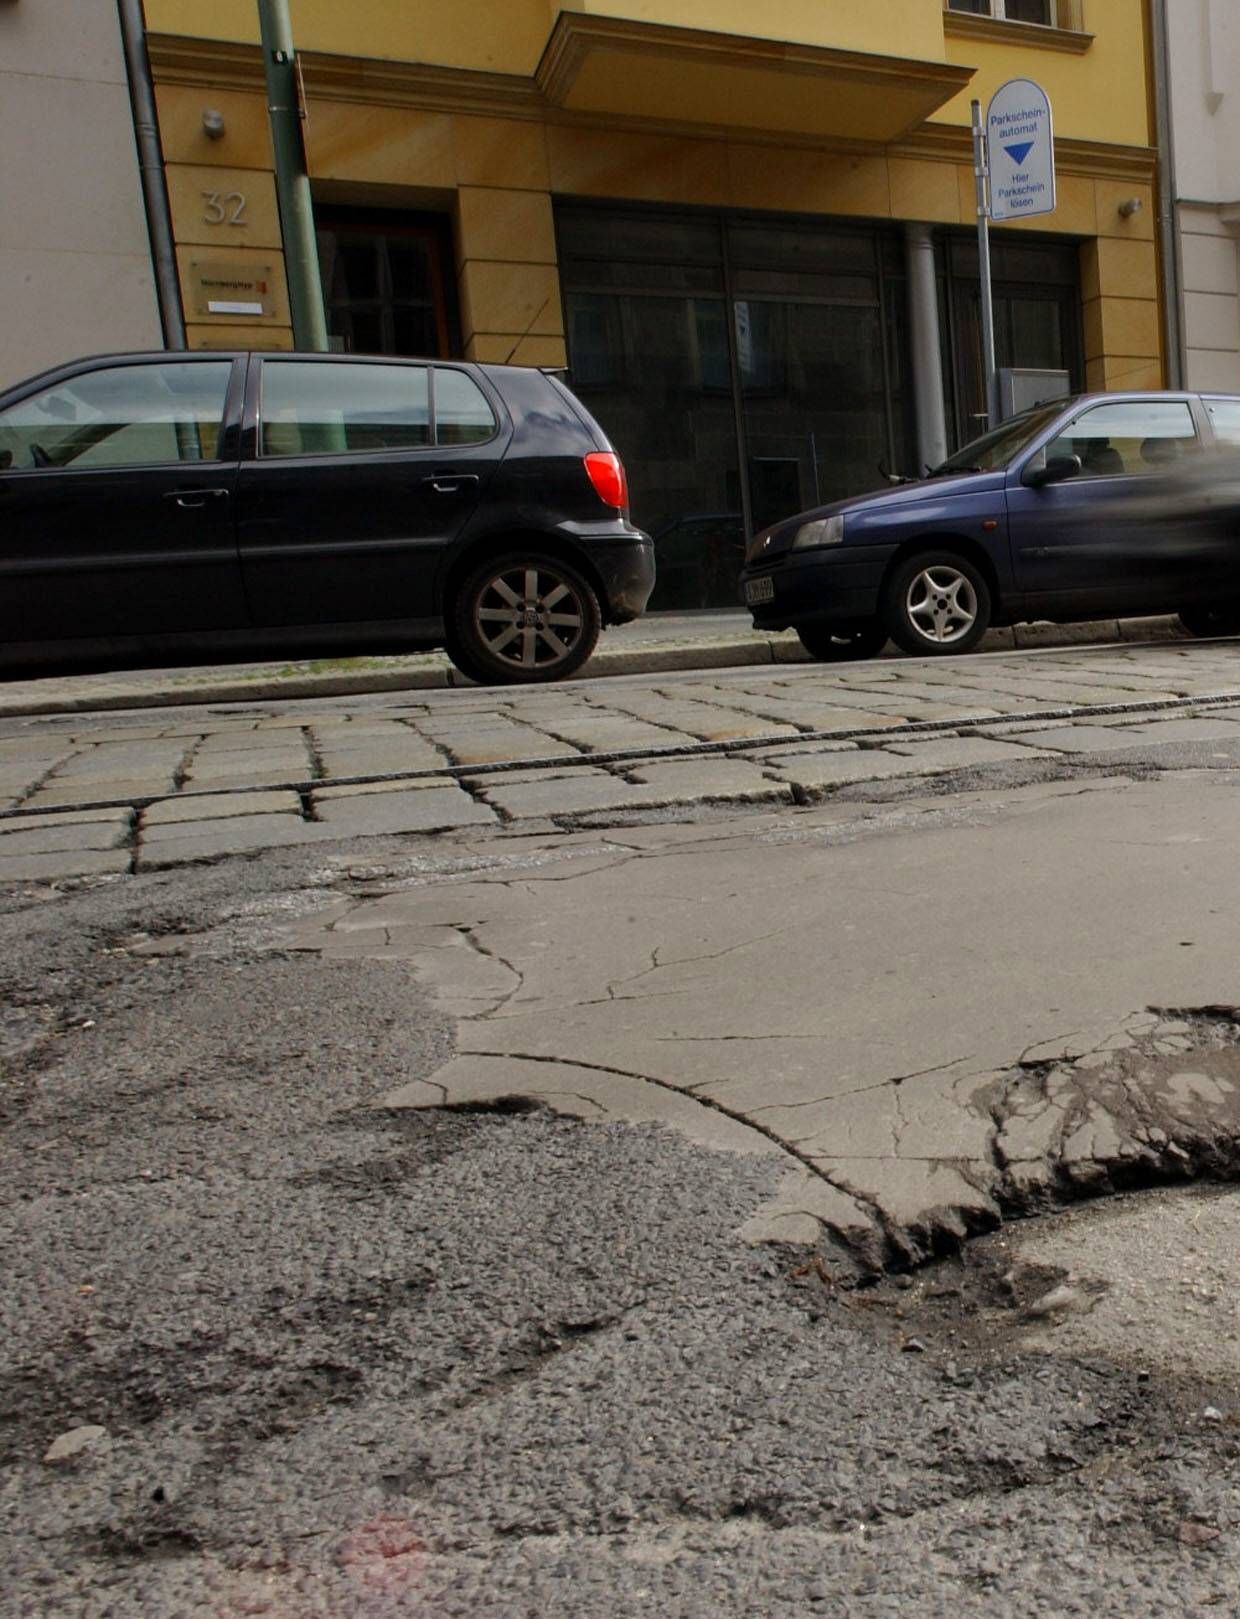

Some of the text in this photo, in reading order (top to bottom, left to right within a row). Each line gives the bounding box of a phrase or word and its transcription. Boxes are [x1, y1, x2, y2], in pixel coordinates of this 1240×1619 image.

[990, 108, 1046, 125] Parkschein-
[999, 122, 1037, 138] automat
[1012, 173, 1029, 183] Hier
[998, 183, 1045, 198] Parkschein
[202, 190, 247, 226] 32
